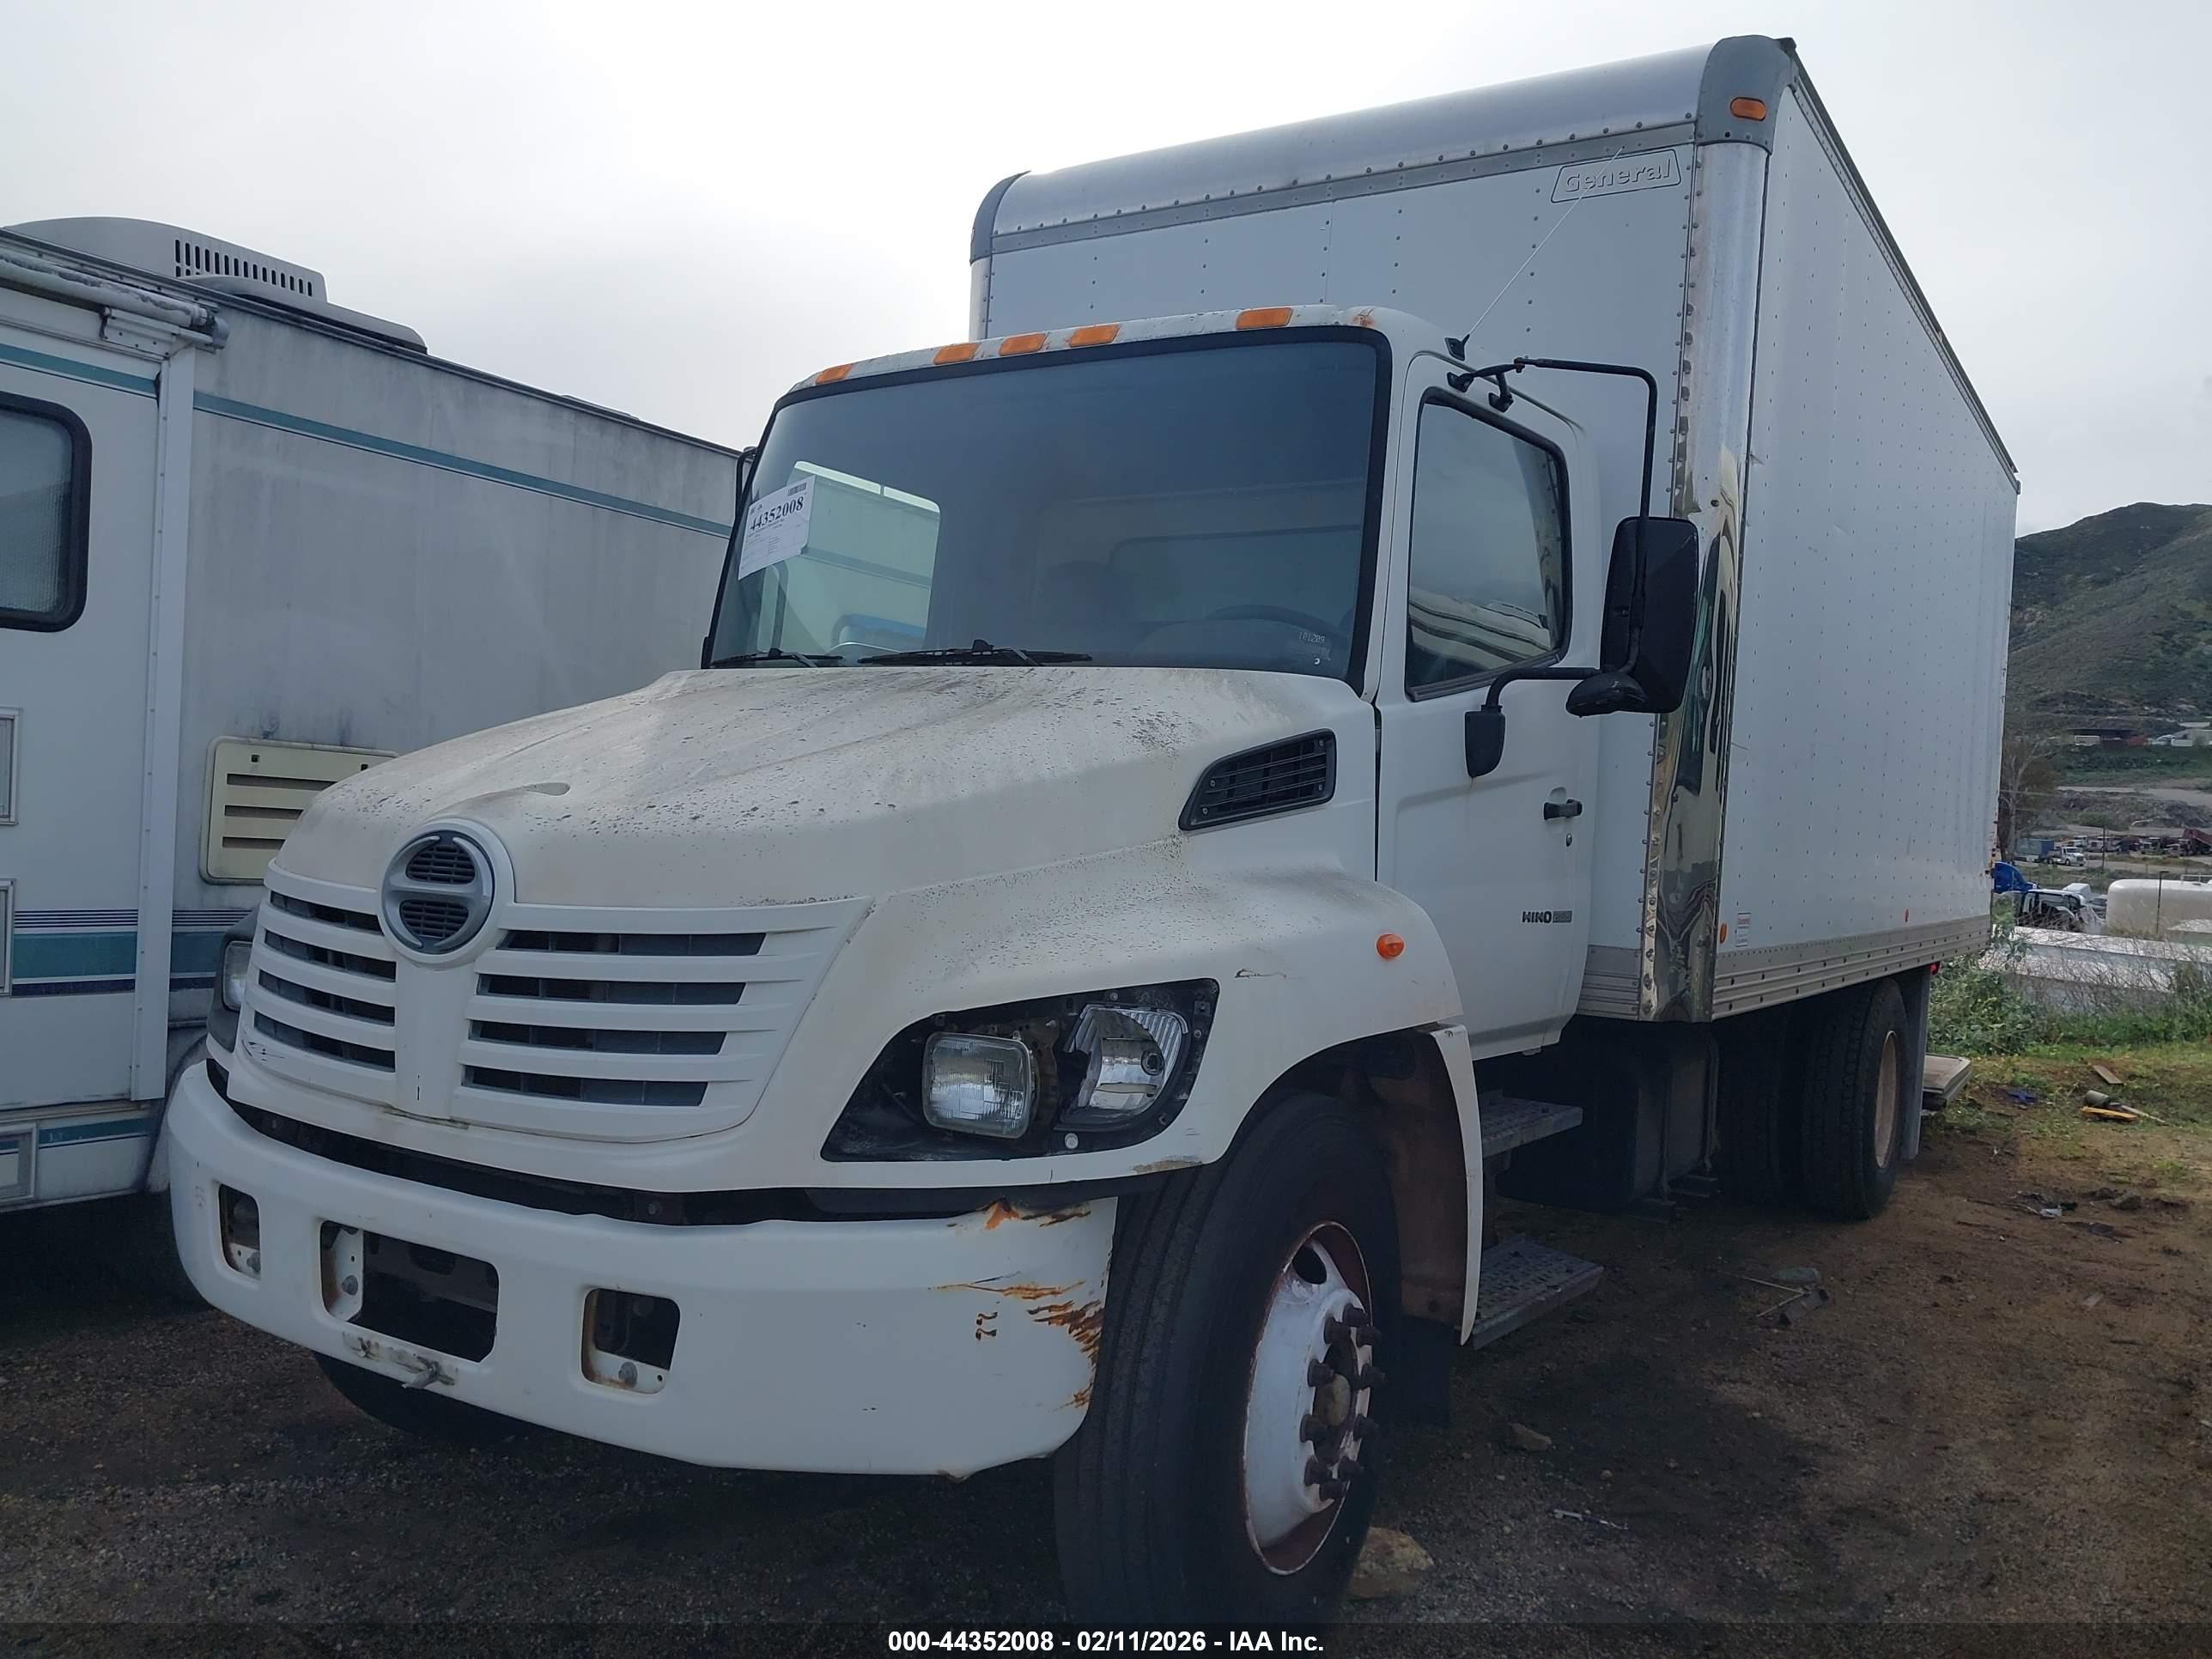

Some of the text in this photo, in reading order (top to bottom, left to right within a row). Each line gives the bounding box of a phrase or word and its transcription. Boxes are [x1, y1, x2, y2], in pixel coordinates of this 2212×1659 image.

[1565, 159, 1671, 192] General
[750, 496, 805, 531] 44352008
[1522, 910, 1553, 924] HINO
